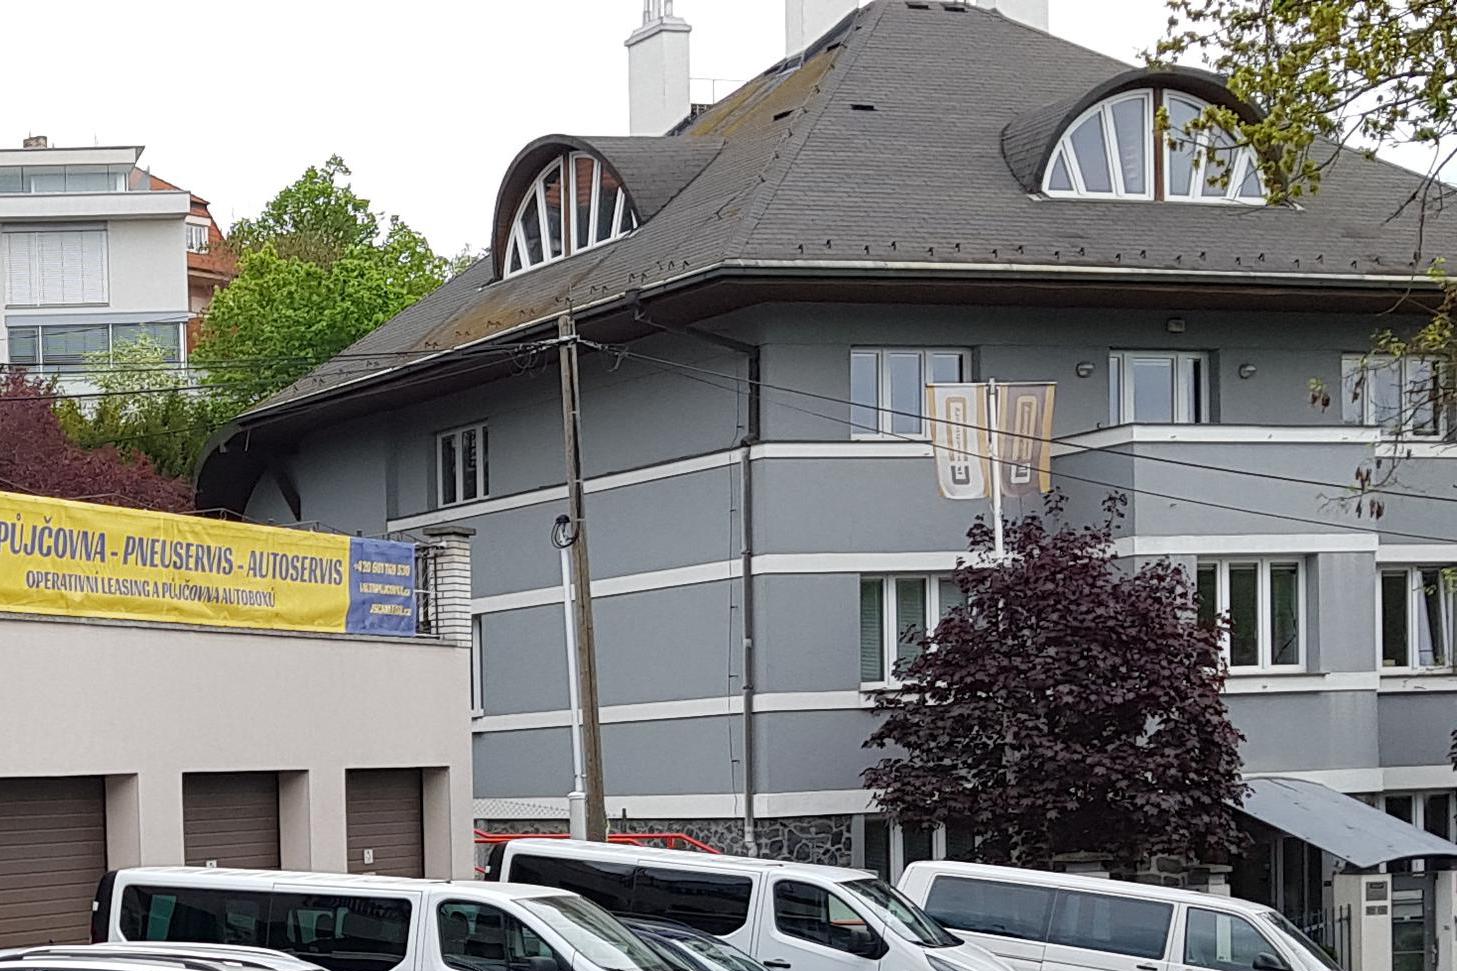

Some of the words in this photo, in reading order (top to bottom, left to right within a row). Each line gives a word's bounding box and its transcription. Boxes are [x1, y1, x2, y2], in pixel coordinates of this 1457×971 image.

[122, 536, 234, 576] PNEUSERVIS
[247, 550, 343, 586] AUTOSERVIS
[26, 570, 99, 593] OPERATIVNÍ
[102, 577, 150, 597] LEASING
[152, 581, 160, 598] A
